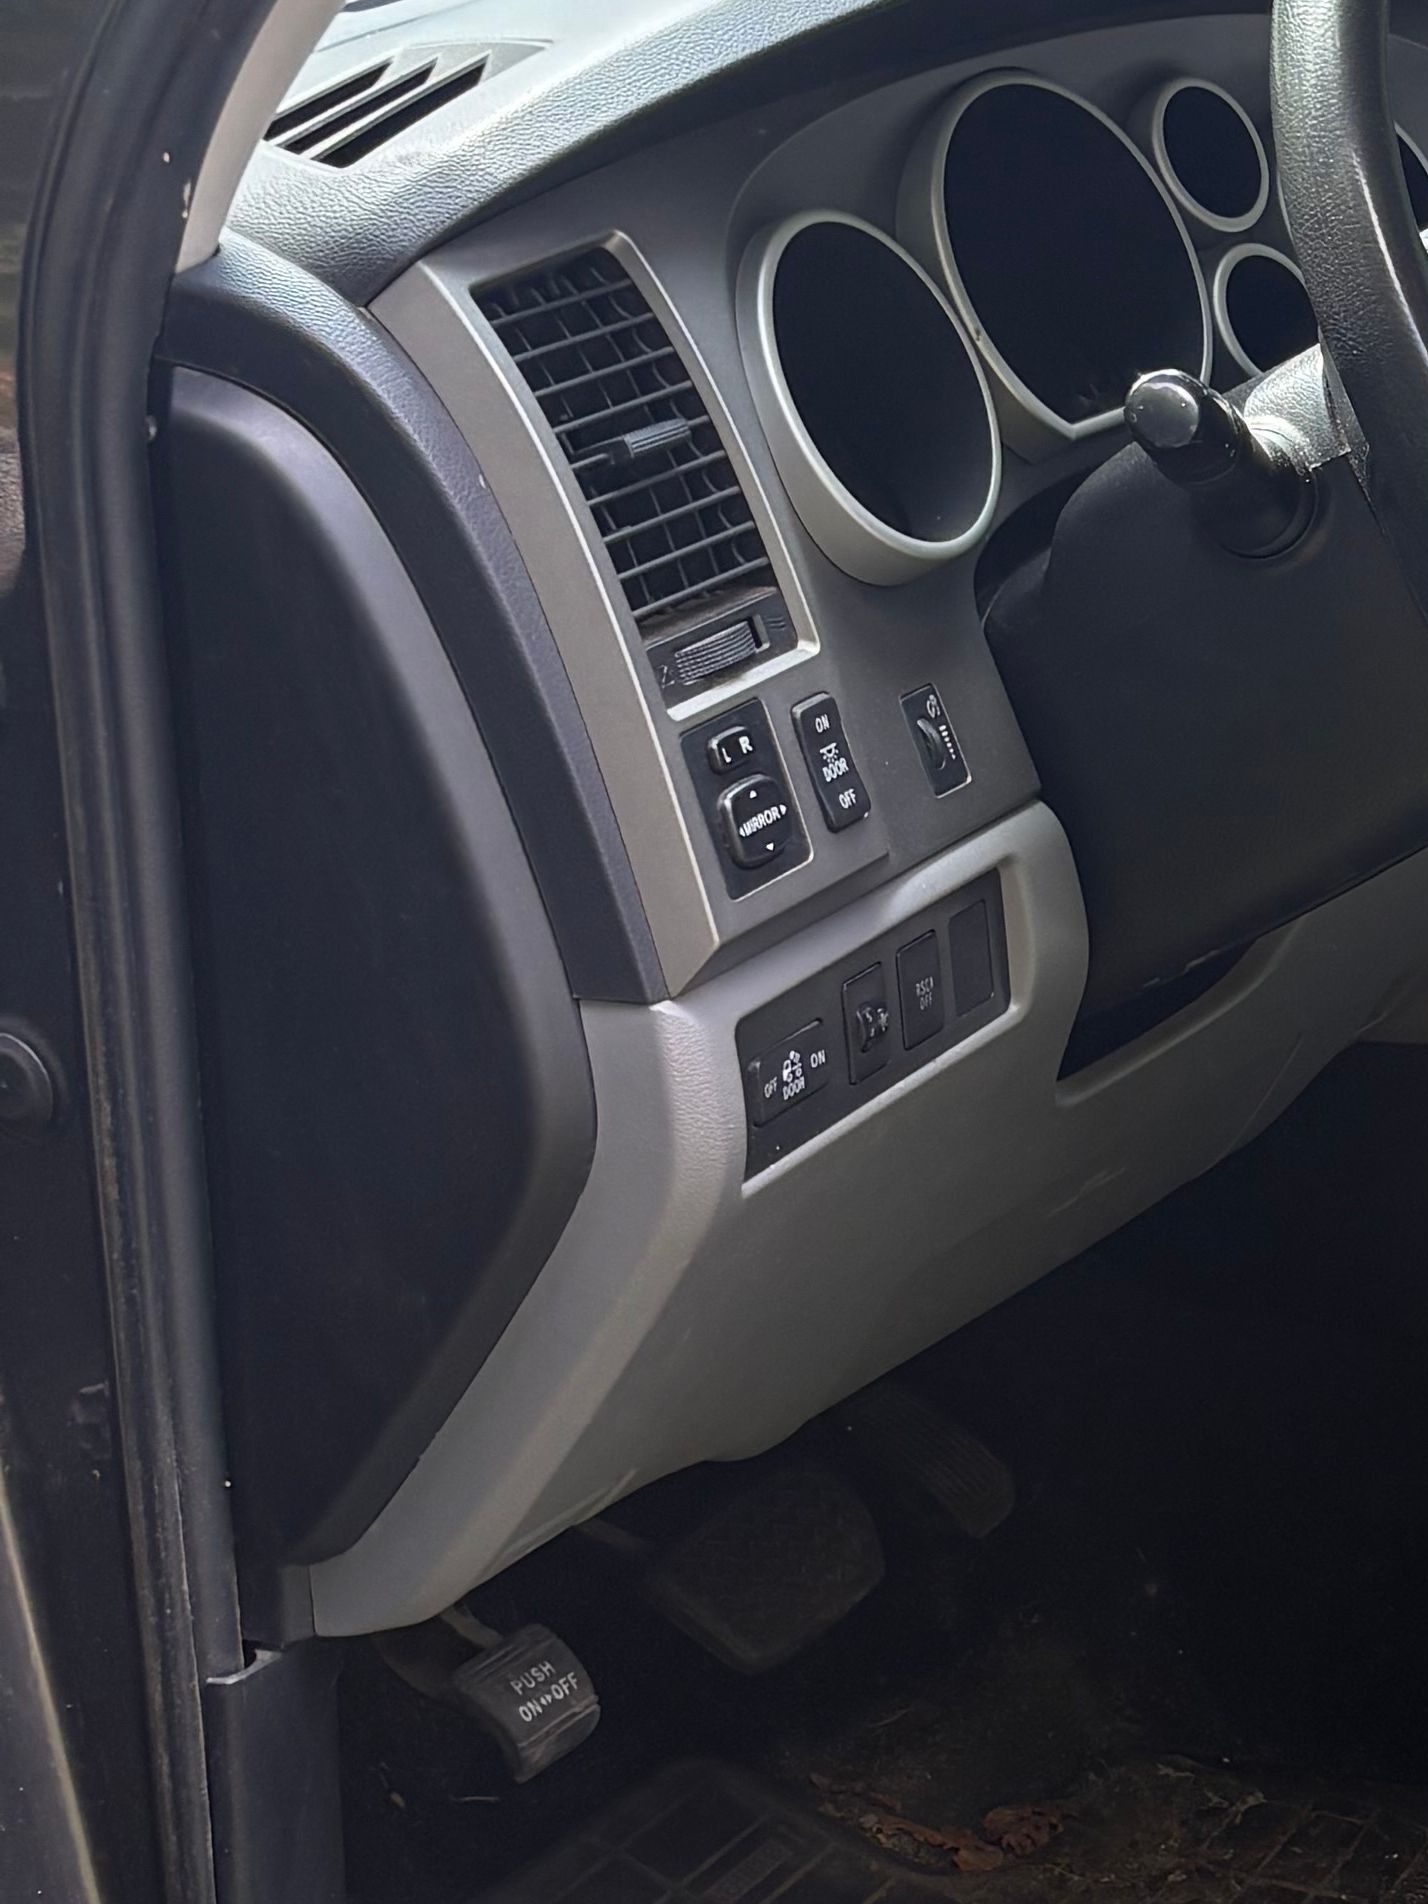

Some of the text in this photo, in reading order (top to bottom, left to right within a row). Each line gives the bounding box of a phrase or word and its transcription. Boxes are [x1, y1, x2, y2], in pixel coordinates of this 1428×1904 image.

[815, 713, 830, 733] ON
[738, 736, 753, 754] R
[822, 757, 849, 783] DOOR
[838, 788, 857, 809] OFF
[743, 806, 781, 837] MIRROR
[810, 1049, 827, 1069] ON
[764, 1076, 778, 1099] OFF
[782, 1076, 806, 1101] DOOR
[510, 1660, 556, 1696] PUSH
[519, 1671, 578, 1722] ON OFF
